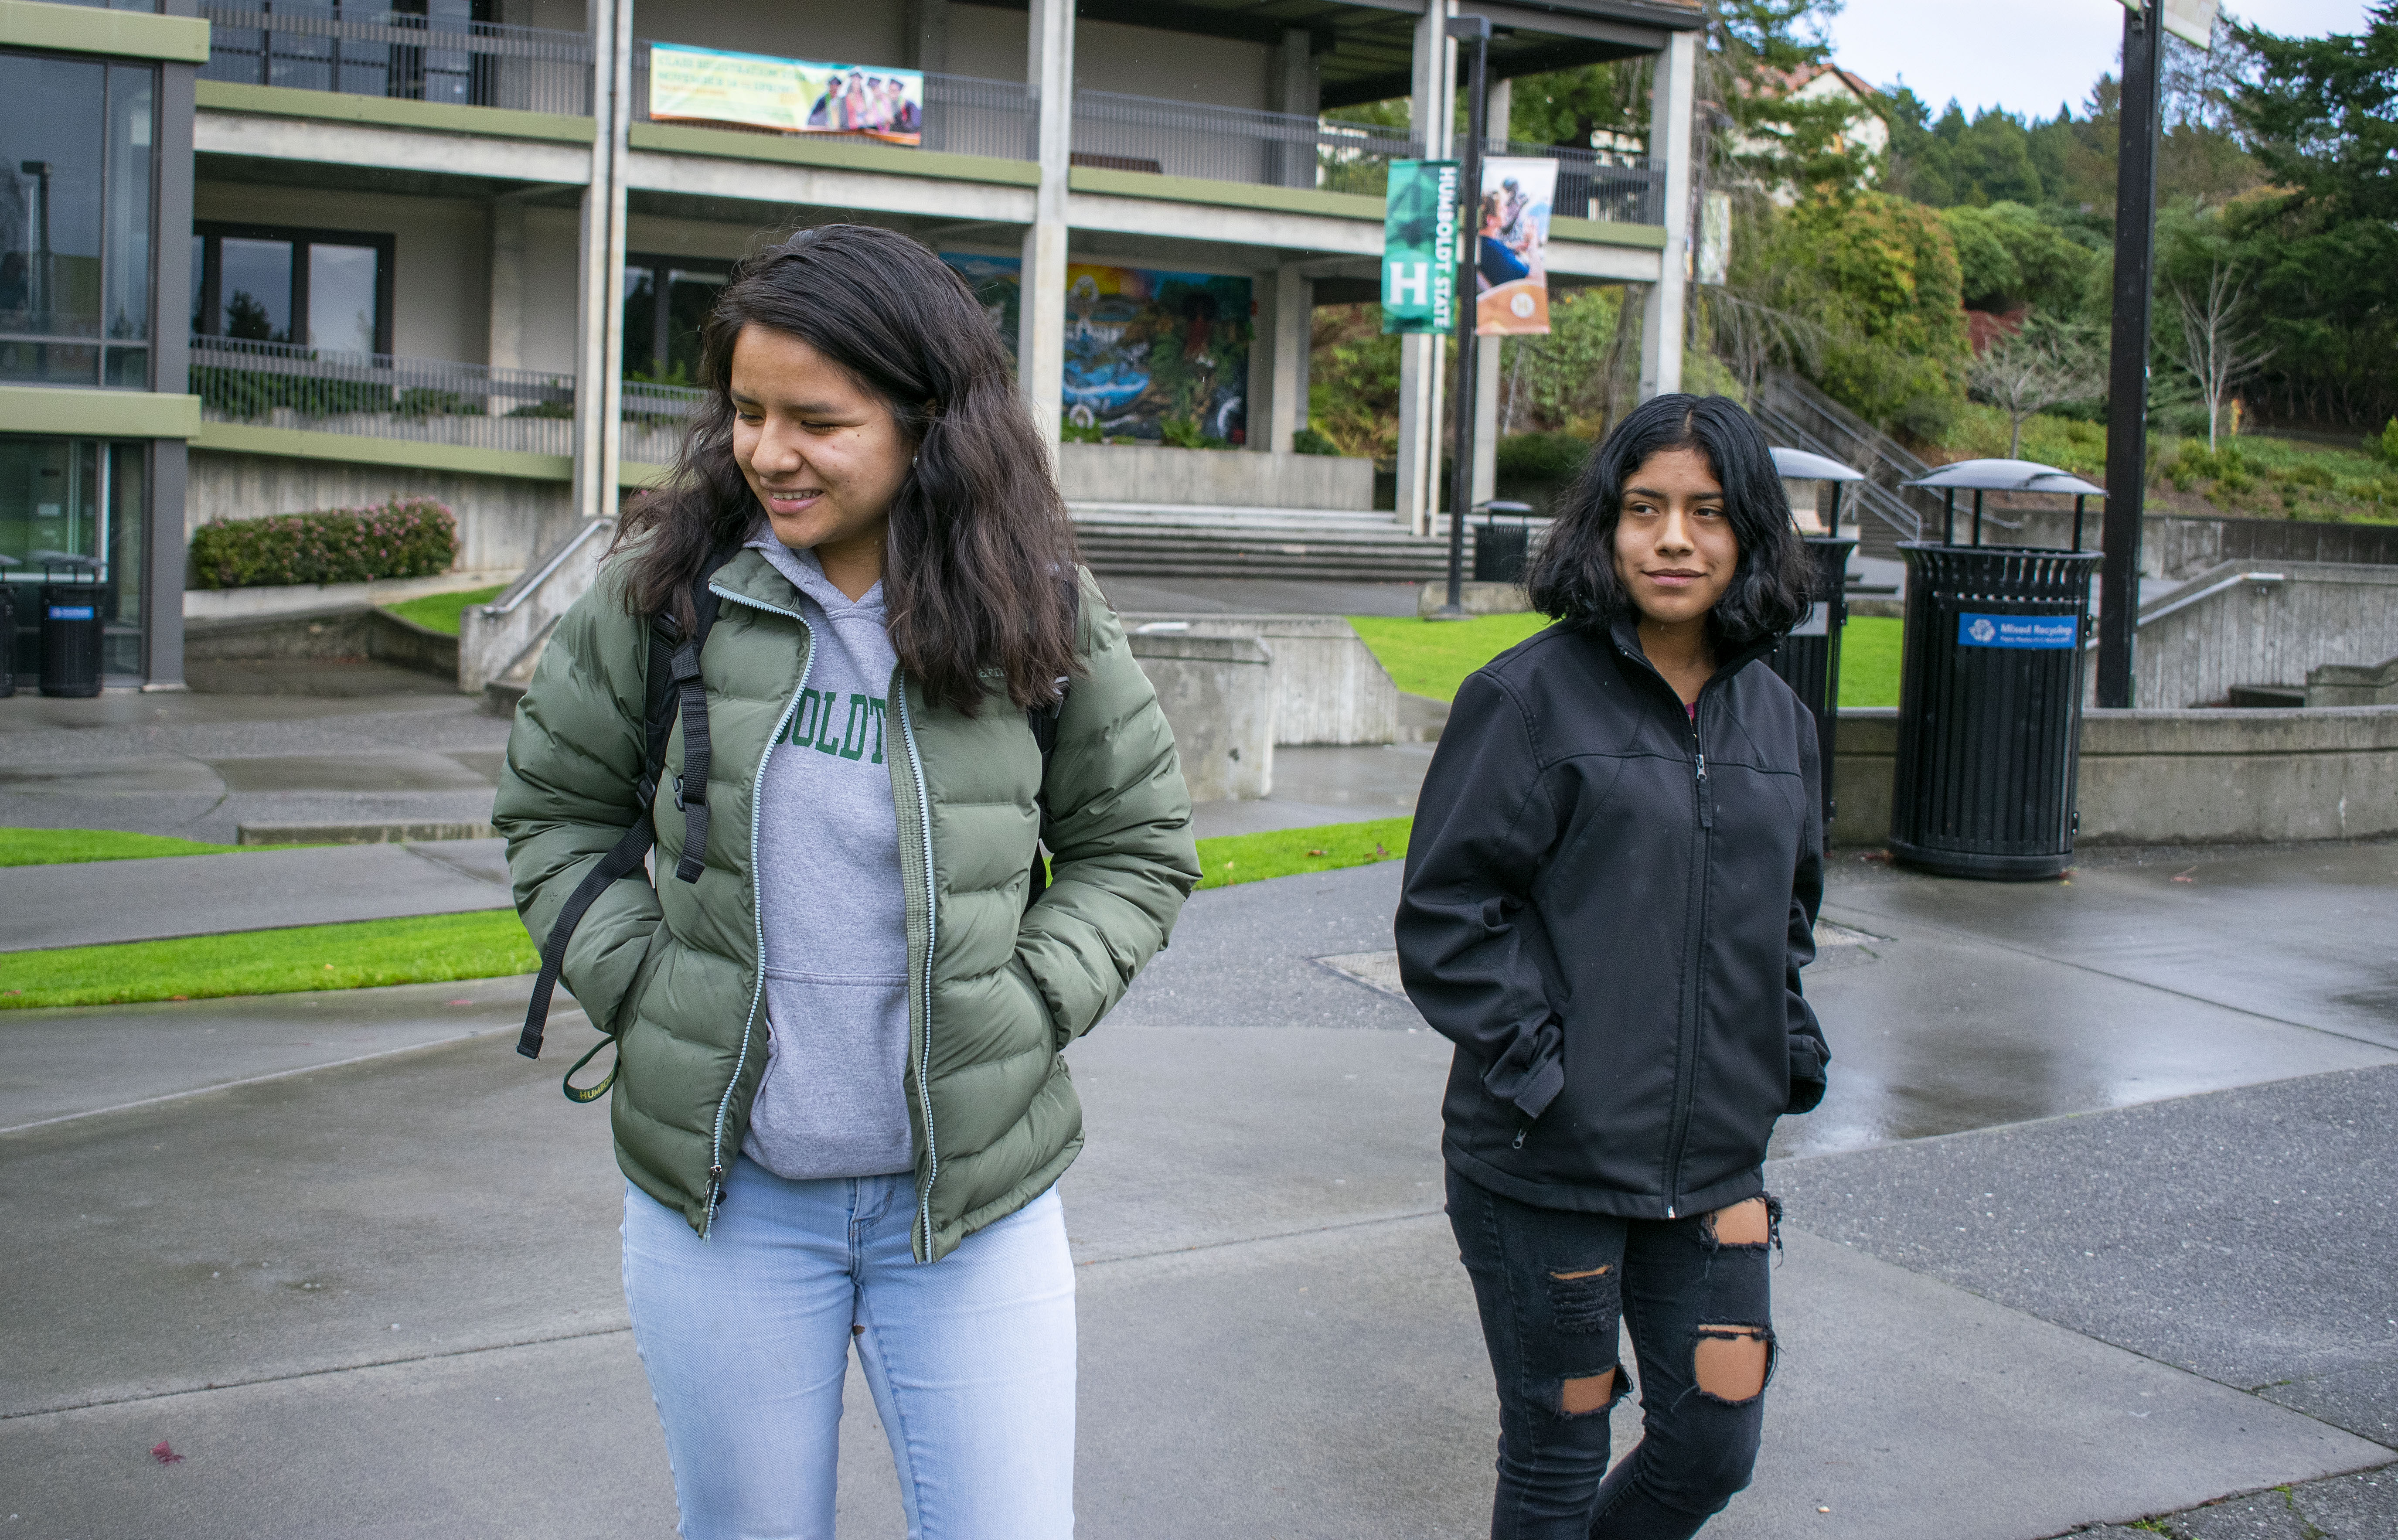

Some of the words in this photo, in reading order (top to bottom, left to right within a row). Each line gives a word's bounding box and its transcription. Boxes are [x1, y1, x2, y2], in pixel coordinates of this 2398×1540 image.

[1435, 167, 1457, 273] HUMBOLDT
[1389, 262, 1428, 305] H
[1433, 277, 1451, 328] STATE
[2000, 623, 2032, 635] Mixed
[2033, 624, 2073, 636] Recycling
